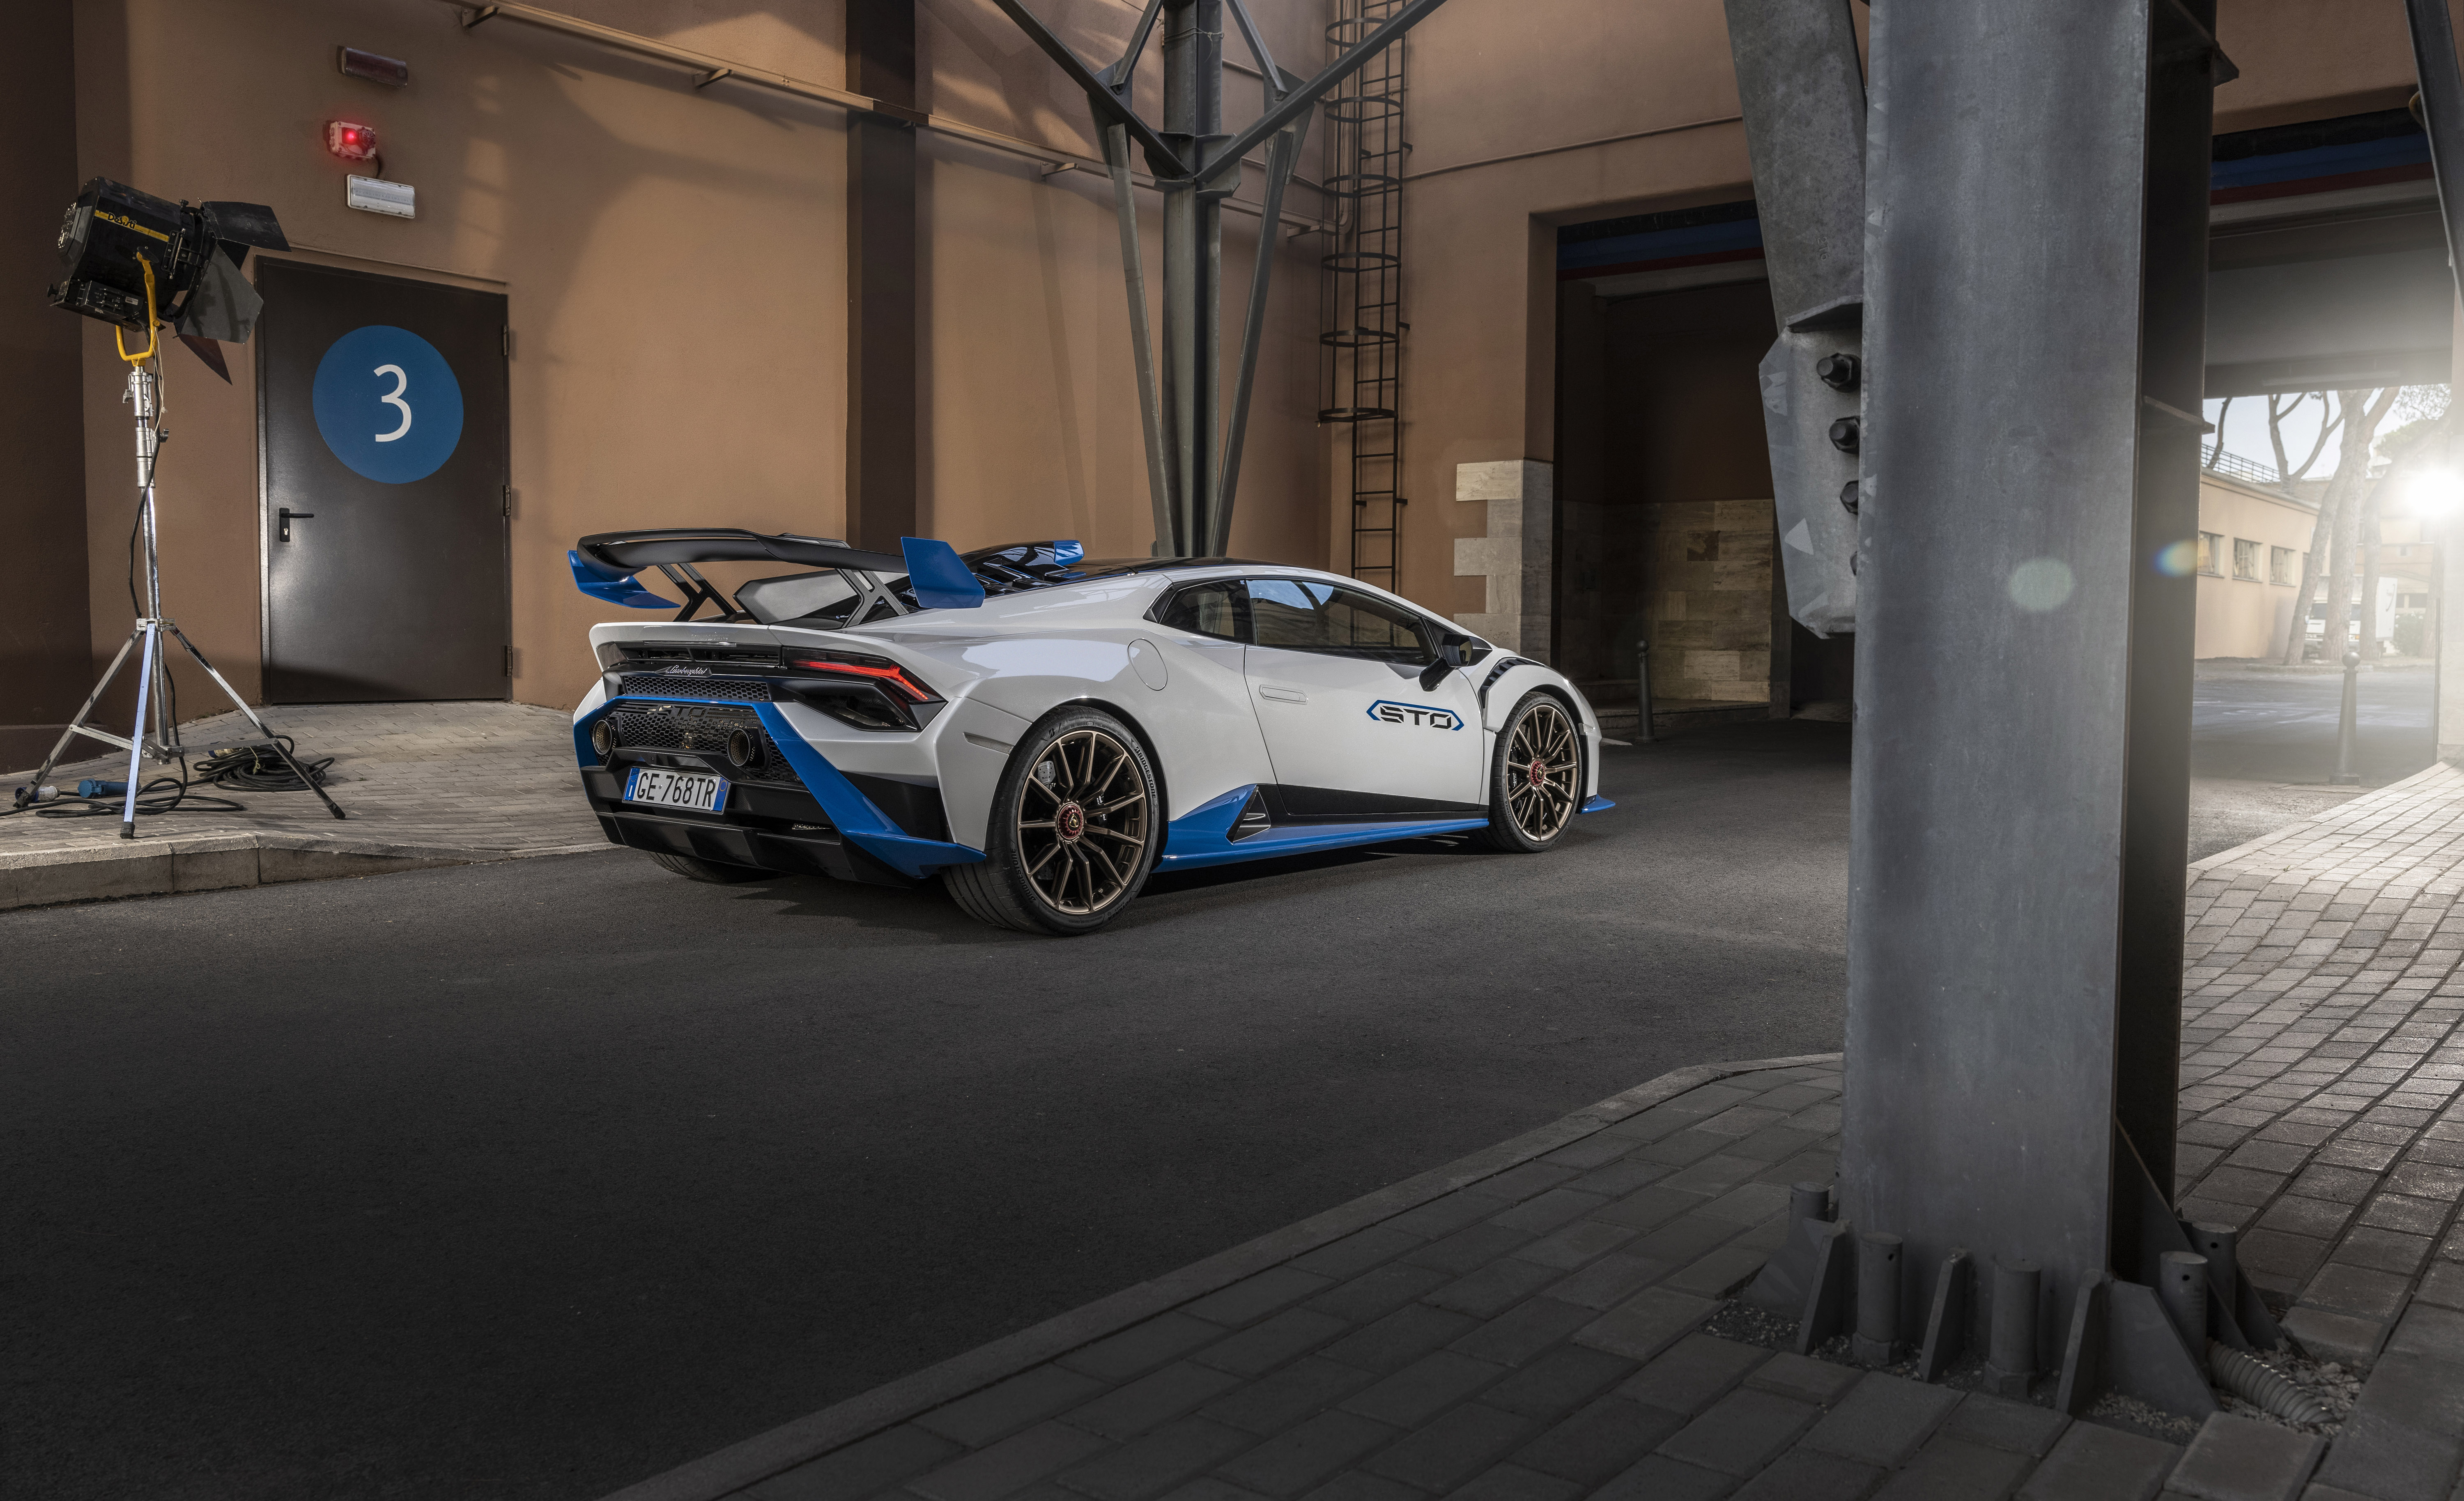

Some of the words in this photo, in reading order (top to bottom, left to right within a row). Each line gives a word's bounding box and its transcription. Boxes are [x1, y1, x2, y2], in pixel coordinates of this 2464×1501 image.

[108, 212, 137, 229] DeSisti
[374, 364, 411, 442] 3
[666, 665, 708, 676] Lamborghini
[657, 705, 707, 718] STO
[1380, 706, 1452, 729] STO
[1134, 746, 1156, 799] BRIDGESTONE
[637, 772, 661, 800] GE
[661, 775, 716, 807] 768TR
[1011, 848, 1037, 903] BRIDGESTONE
